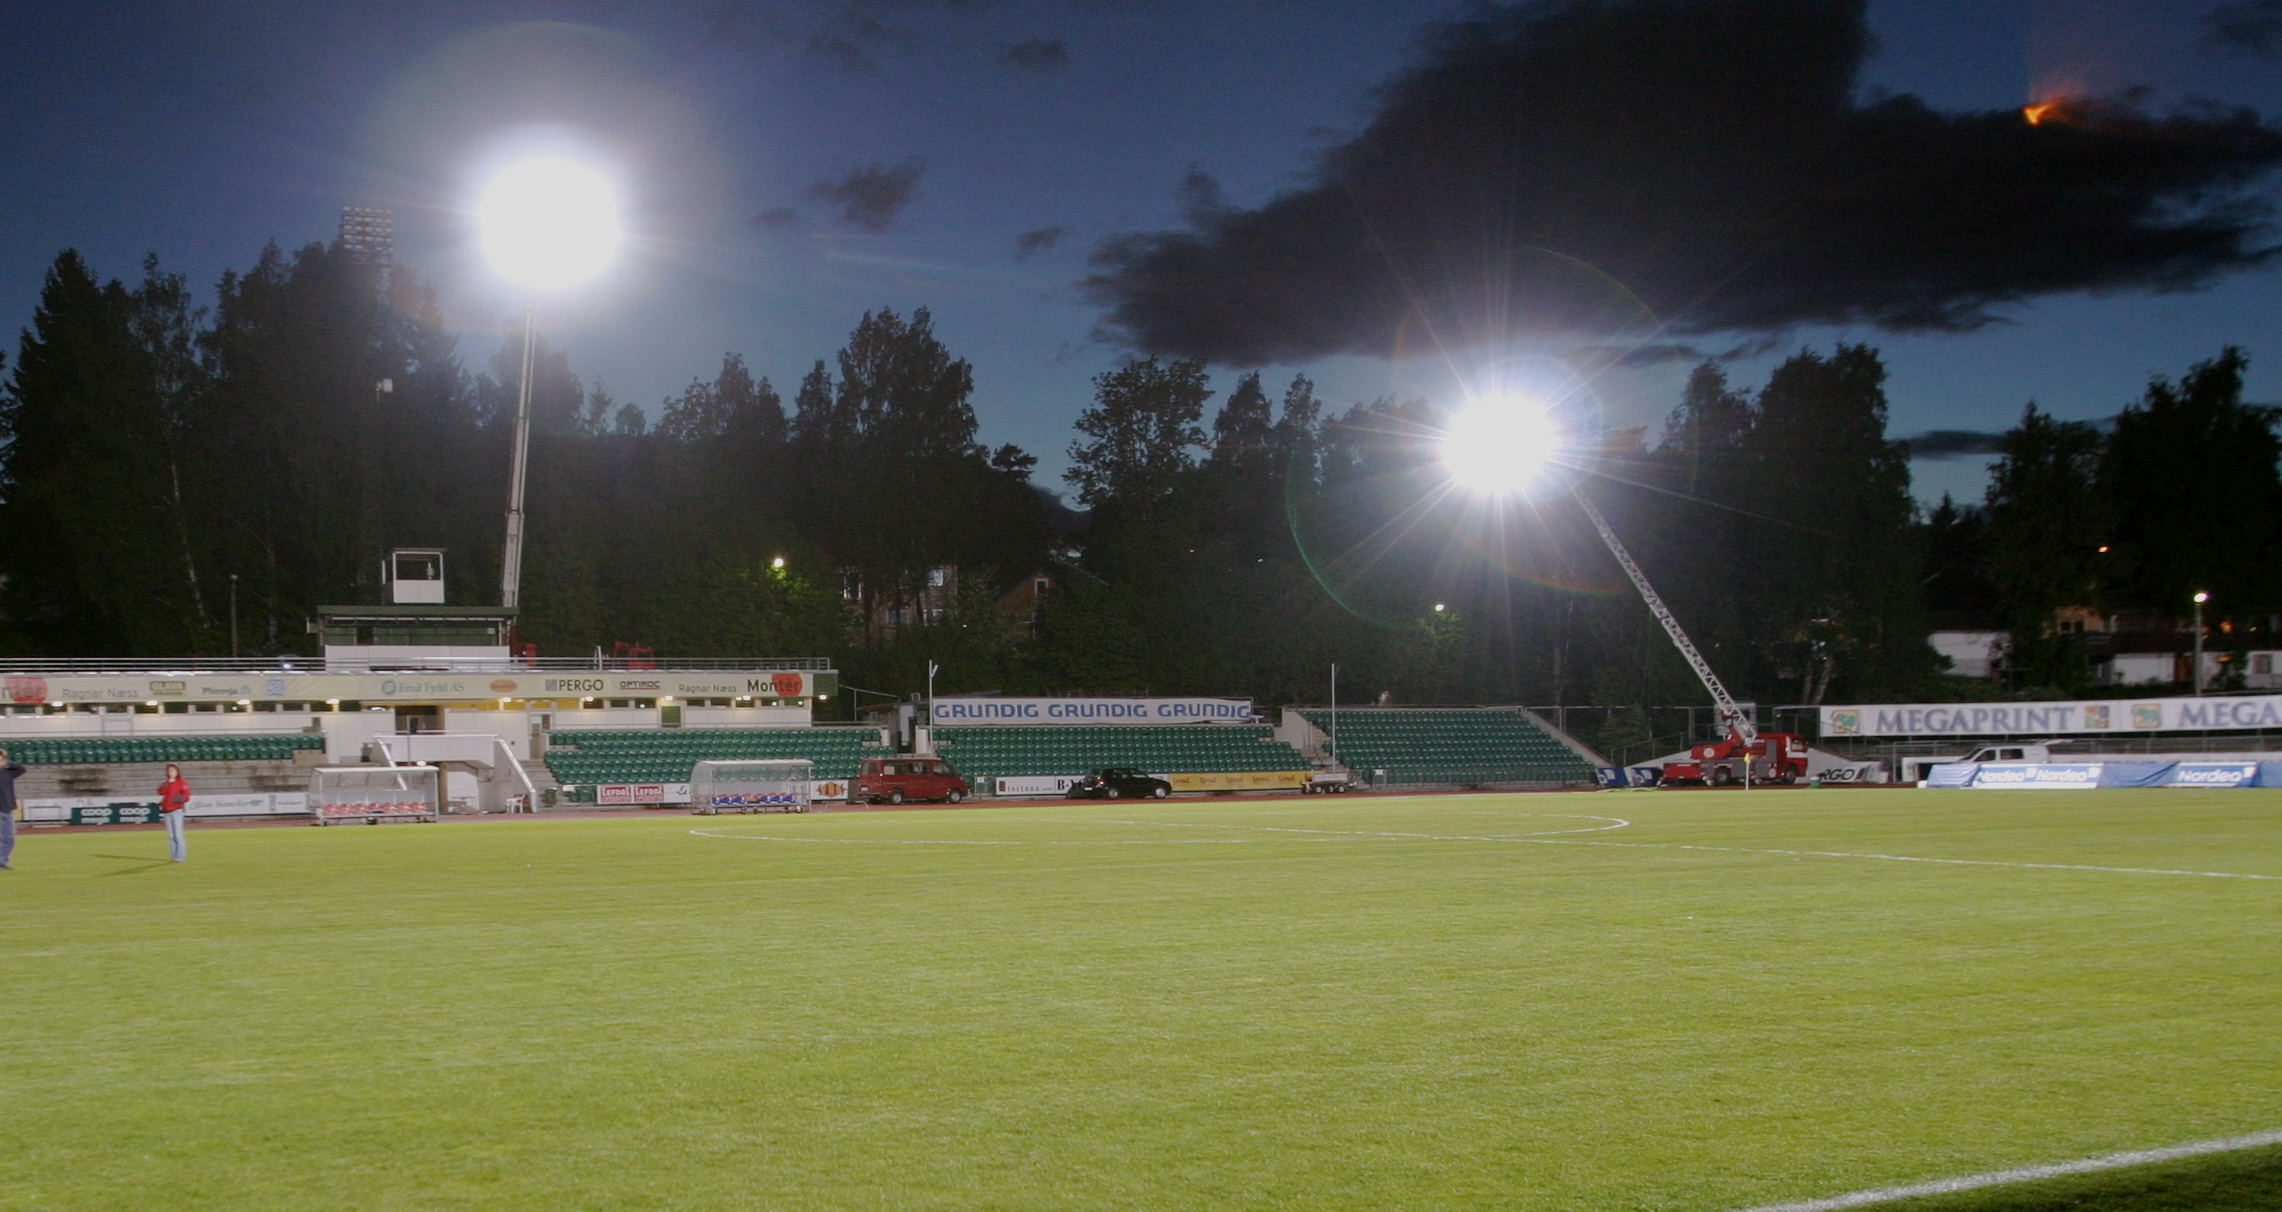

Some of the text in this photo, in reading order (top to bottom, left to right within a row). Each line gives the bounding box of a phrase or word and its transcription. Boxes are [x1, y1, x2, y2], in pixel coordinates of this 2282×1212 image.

[449, 682, 464, 691] AS
[559, 679, 604, 691] PERGO
[679, 683, 736, 694] Ragnar Næss
[62, 688, 138, 700] Ragnar Næss
[934, 704, 1250, 719] GRUNDIG GRUNDIG GRUNDIG
[1875, 706, 2075, 733] MEGAPRINT
[2036, 768, 2088, 782] Nordea
[2177, 769, 2242, 782] Nordea
